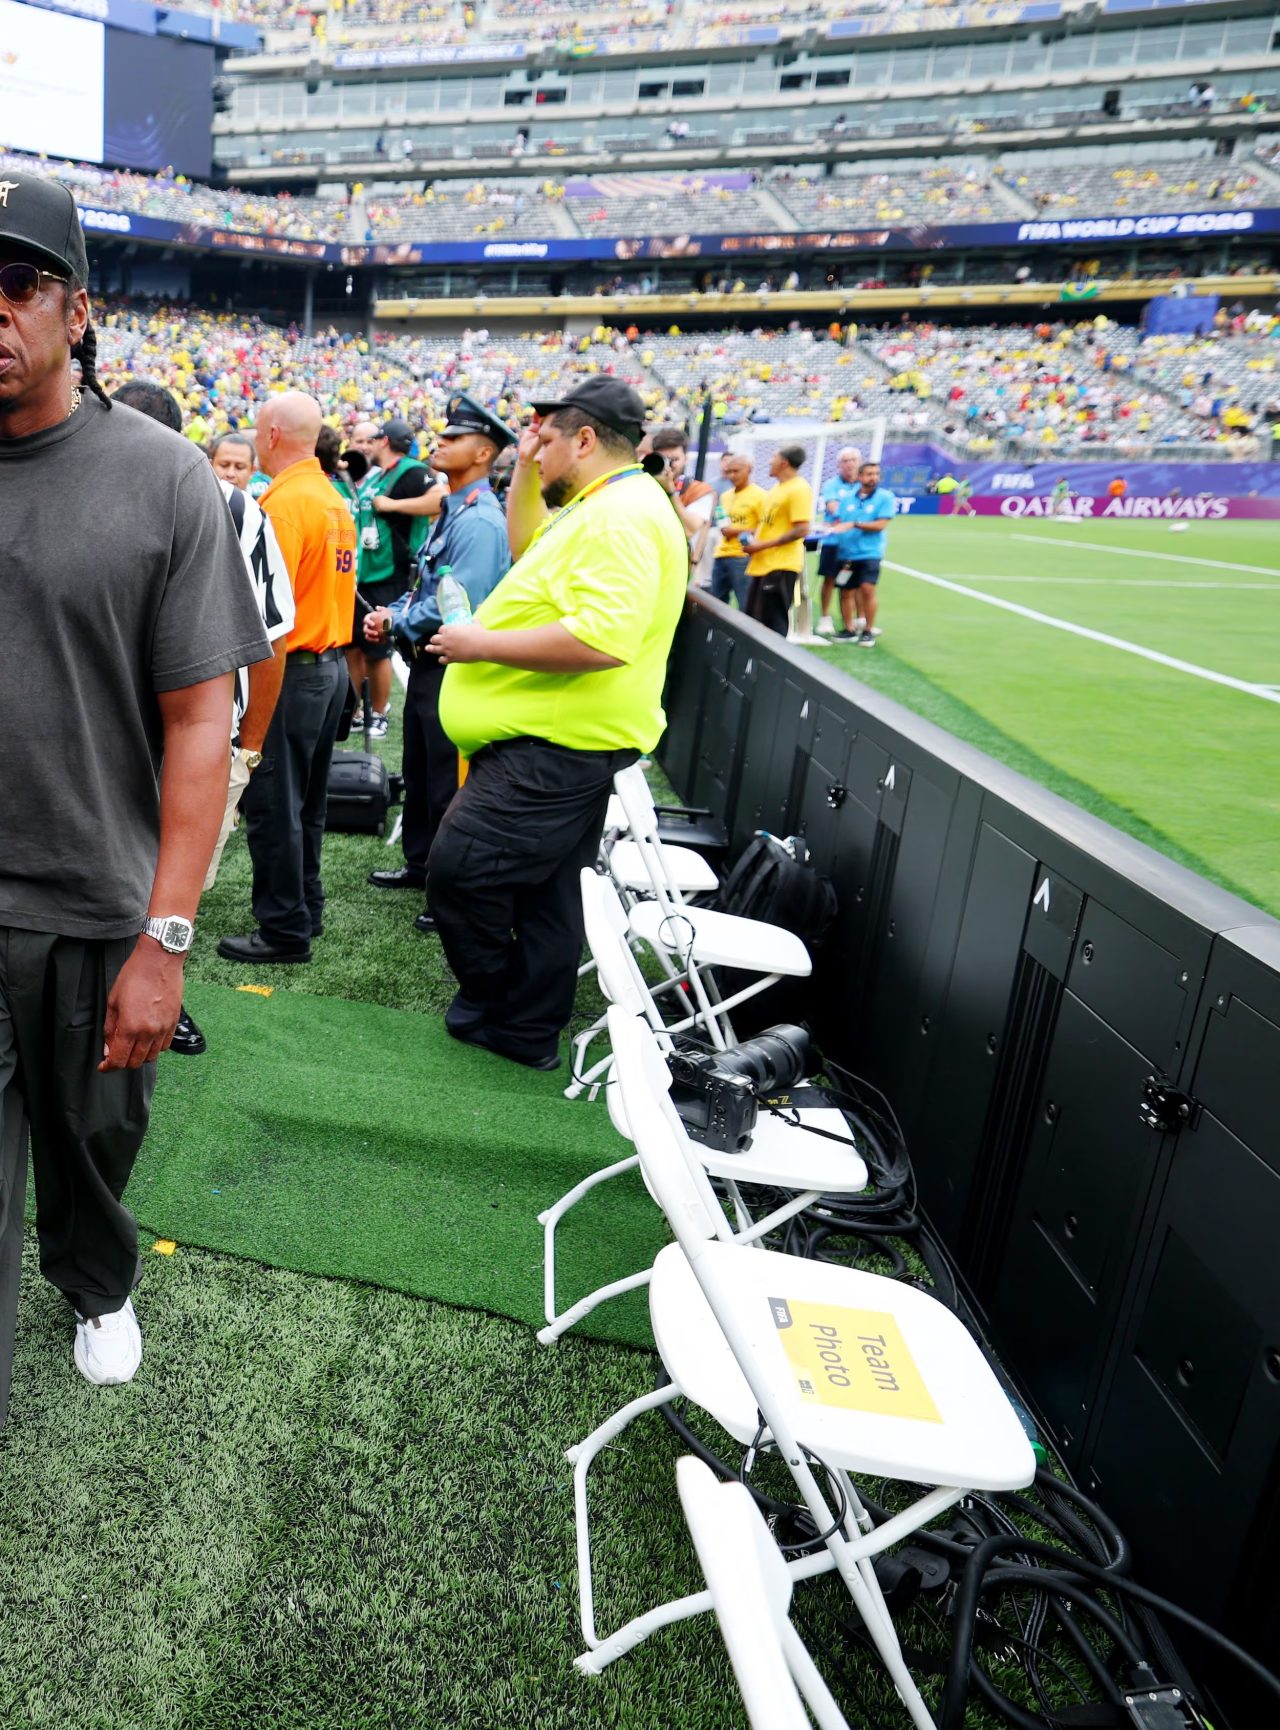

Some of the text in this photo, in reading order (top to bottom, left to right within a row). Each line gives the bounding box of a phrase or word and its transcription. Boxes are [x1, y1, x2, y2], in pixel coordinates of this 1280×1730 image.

[1018, 211, 1254, 241] FIFA WORLD CUP 2026
[991, 473, 1035, 490] FIFA
[1000, 495, 1230, 519] QATAR AIRWAYS
[809, 1324, 851, 1388] Photo
[857, 1334, 901, 1392] Team
